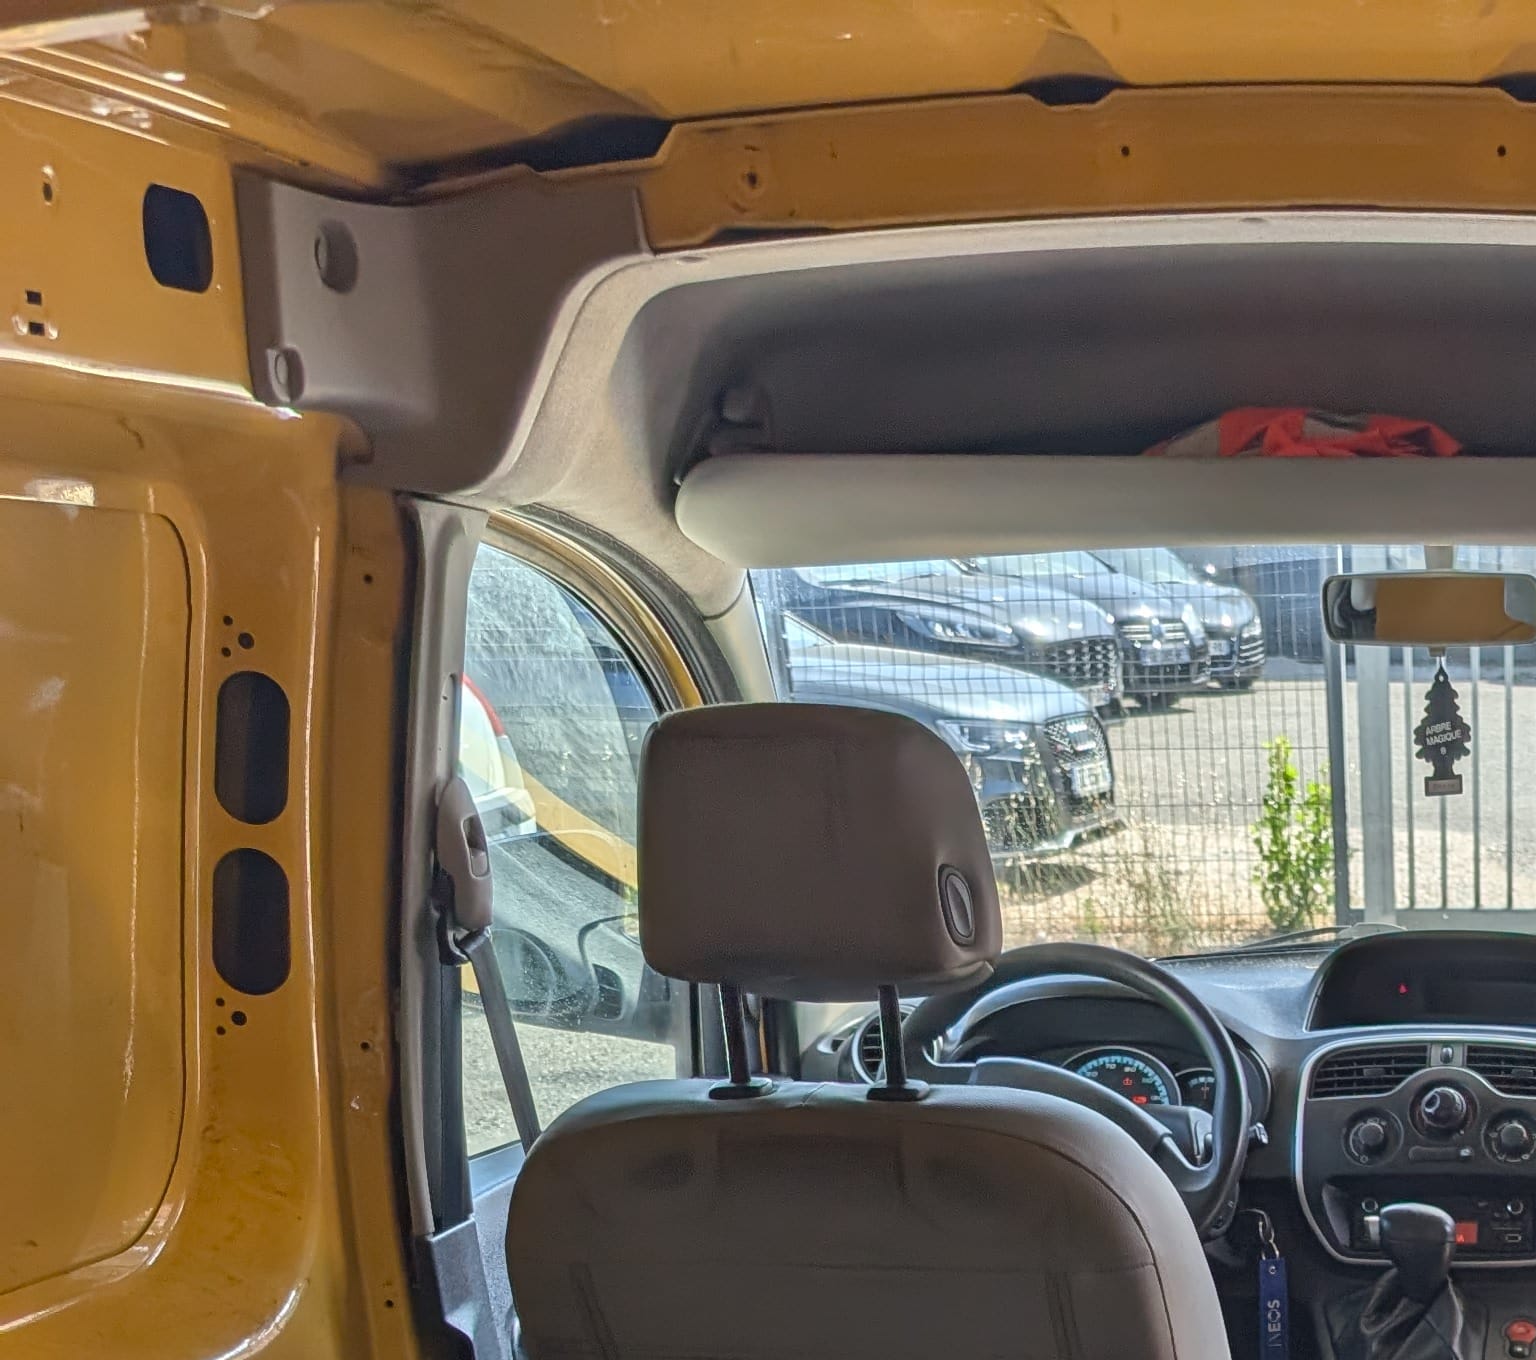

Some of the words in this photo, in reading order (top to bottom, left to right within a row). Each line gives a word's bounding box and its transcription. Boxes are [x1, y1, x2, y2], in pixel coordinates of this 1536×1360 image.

[1425, 721, 1452, 737] ARBRE
[1425, 728, 1463, 746] MAGIQUE
[1266, 1299, 1283, 1348] INEOS
